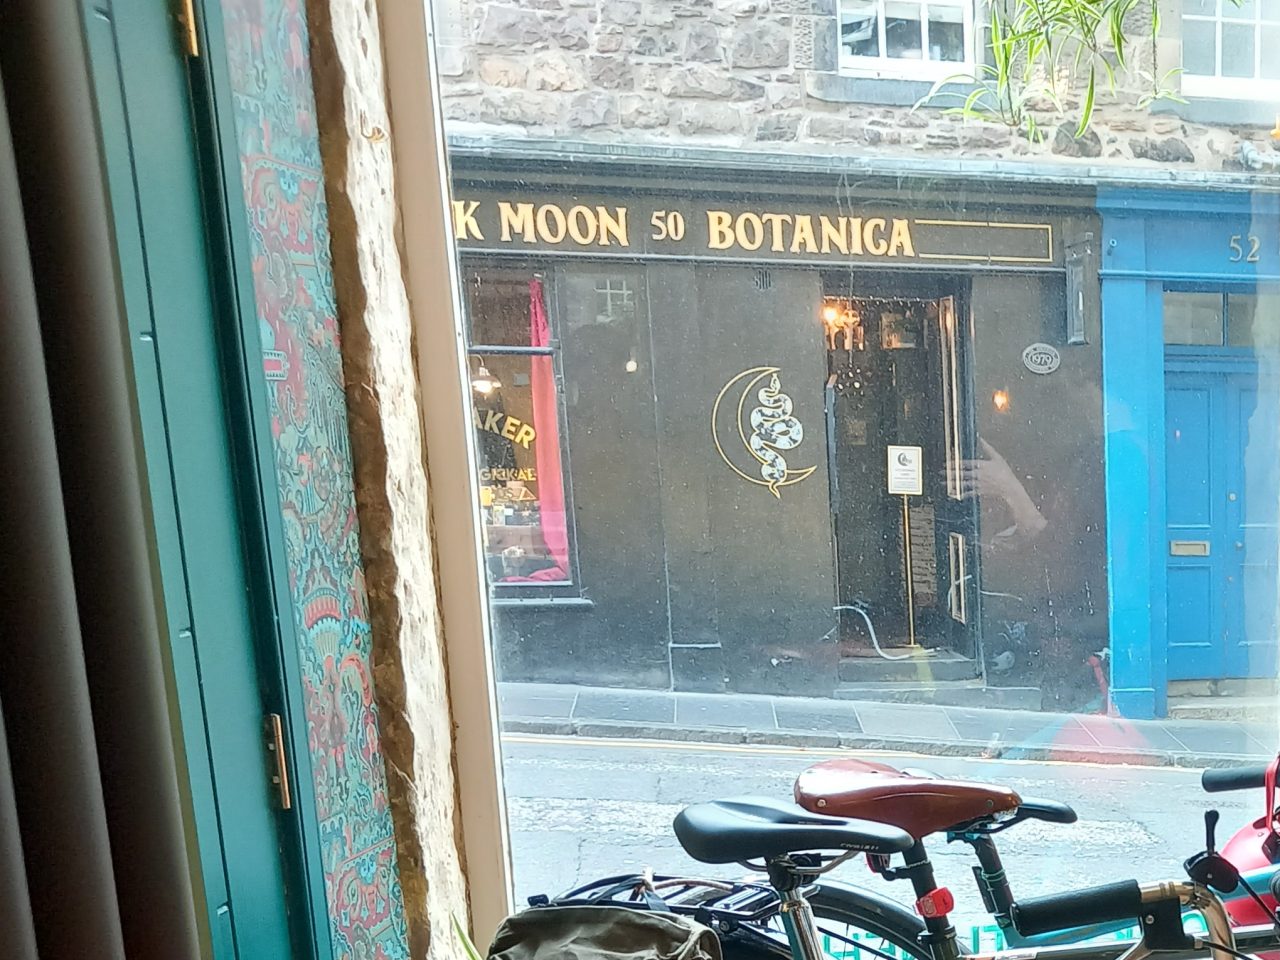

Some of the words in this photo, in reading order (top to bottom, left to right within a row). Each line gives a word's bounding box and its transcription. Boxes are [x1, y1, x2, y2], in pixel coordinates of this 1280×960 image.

[498, 201, 630, 247] MOON
[651, 210, 685, 242] 50
[706, 210, 916, 257] BOTANICA
[1229, 234, 1260, 262] 52
